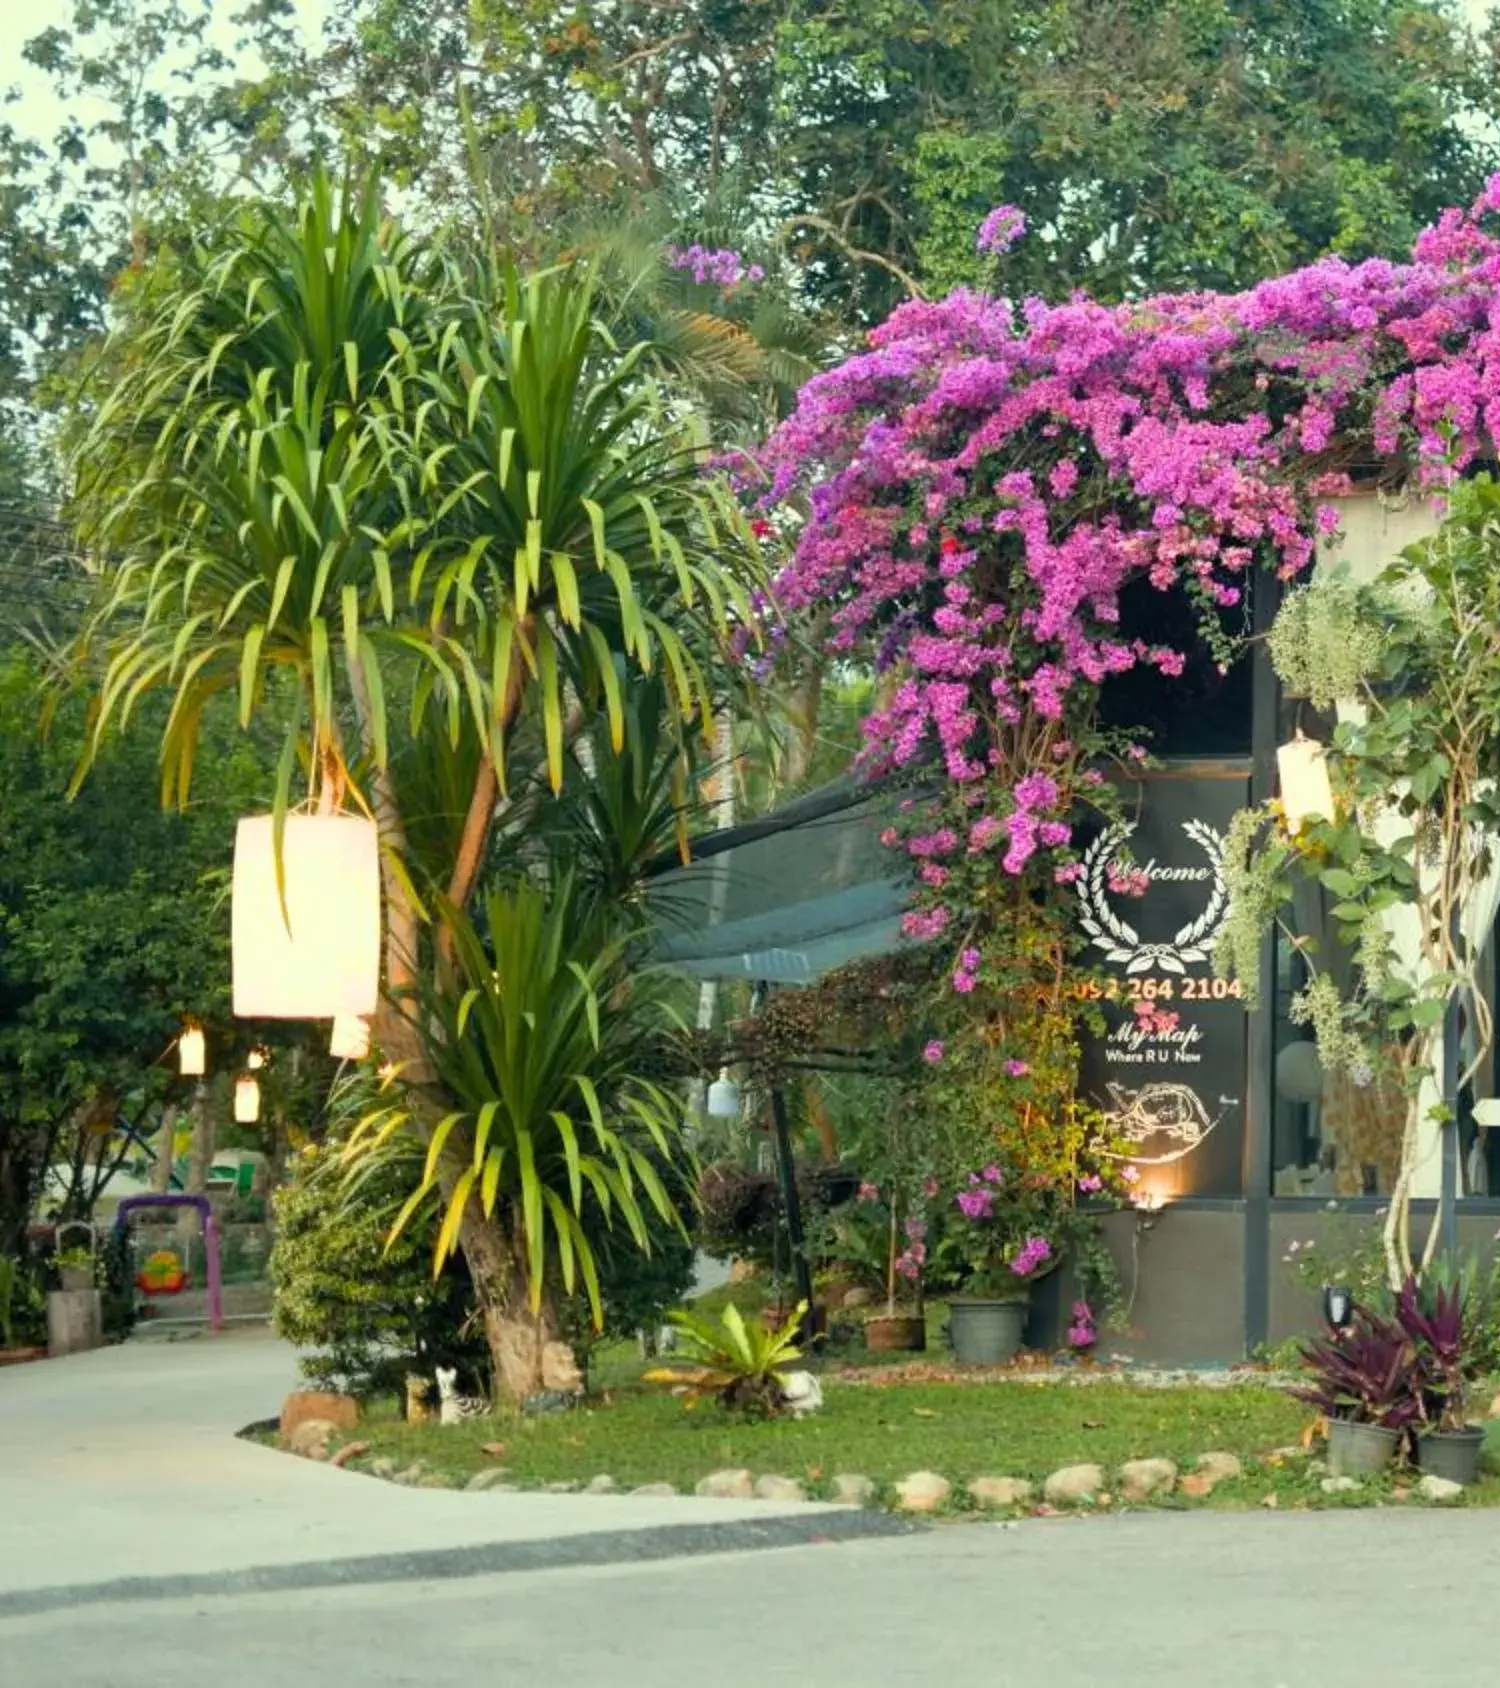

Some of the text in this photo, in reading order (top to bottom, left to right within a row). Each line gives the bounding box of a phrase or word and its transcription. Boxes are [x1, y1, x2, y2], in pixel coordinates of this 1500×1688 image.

[1127, 977, 1173, 999] 264
[1181, 977, 1242, 999] 2104
[1107, 1021, 1147, 1051] My
[1105, 1049, 1144, 1063] Where
[1146, 1049, 1157, 1063] R
[1158, 1049, 1169, 1063] U
